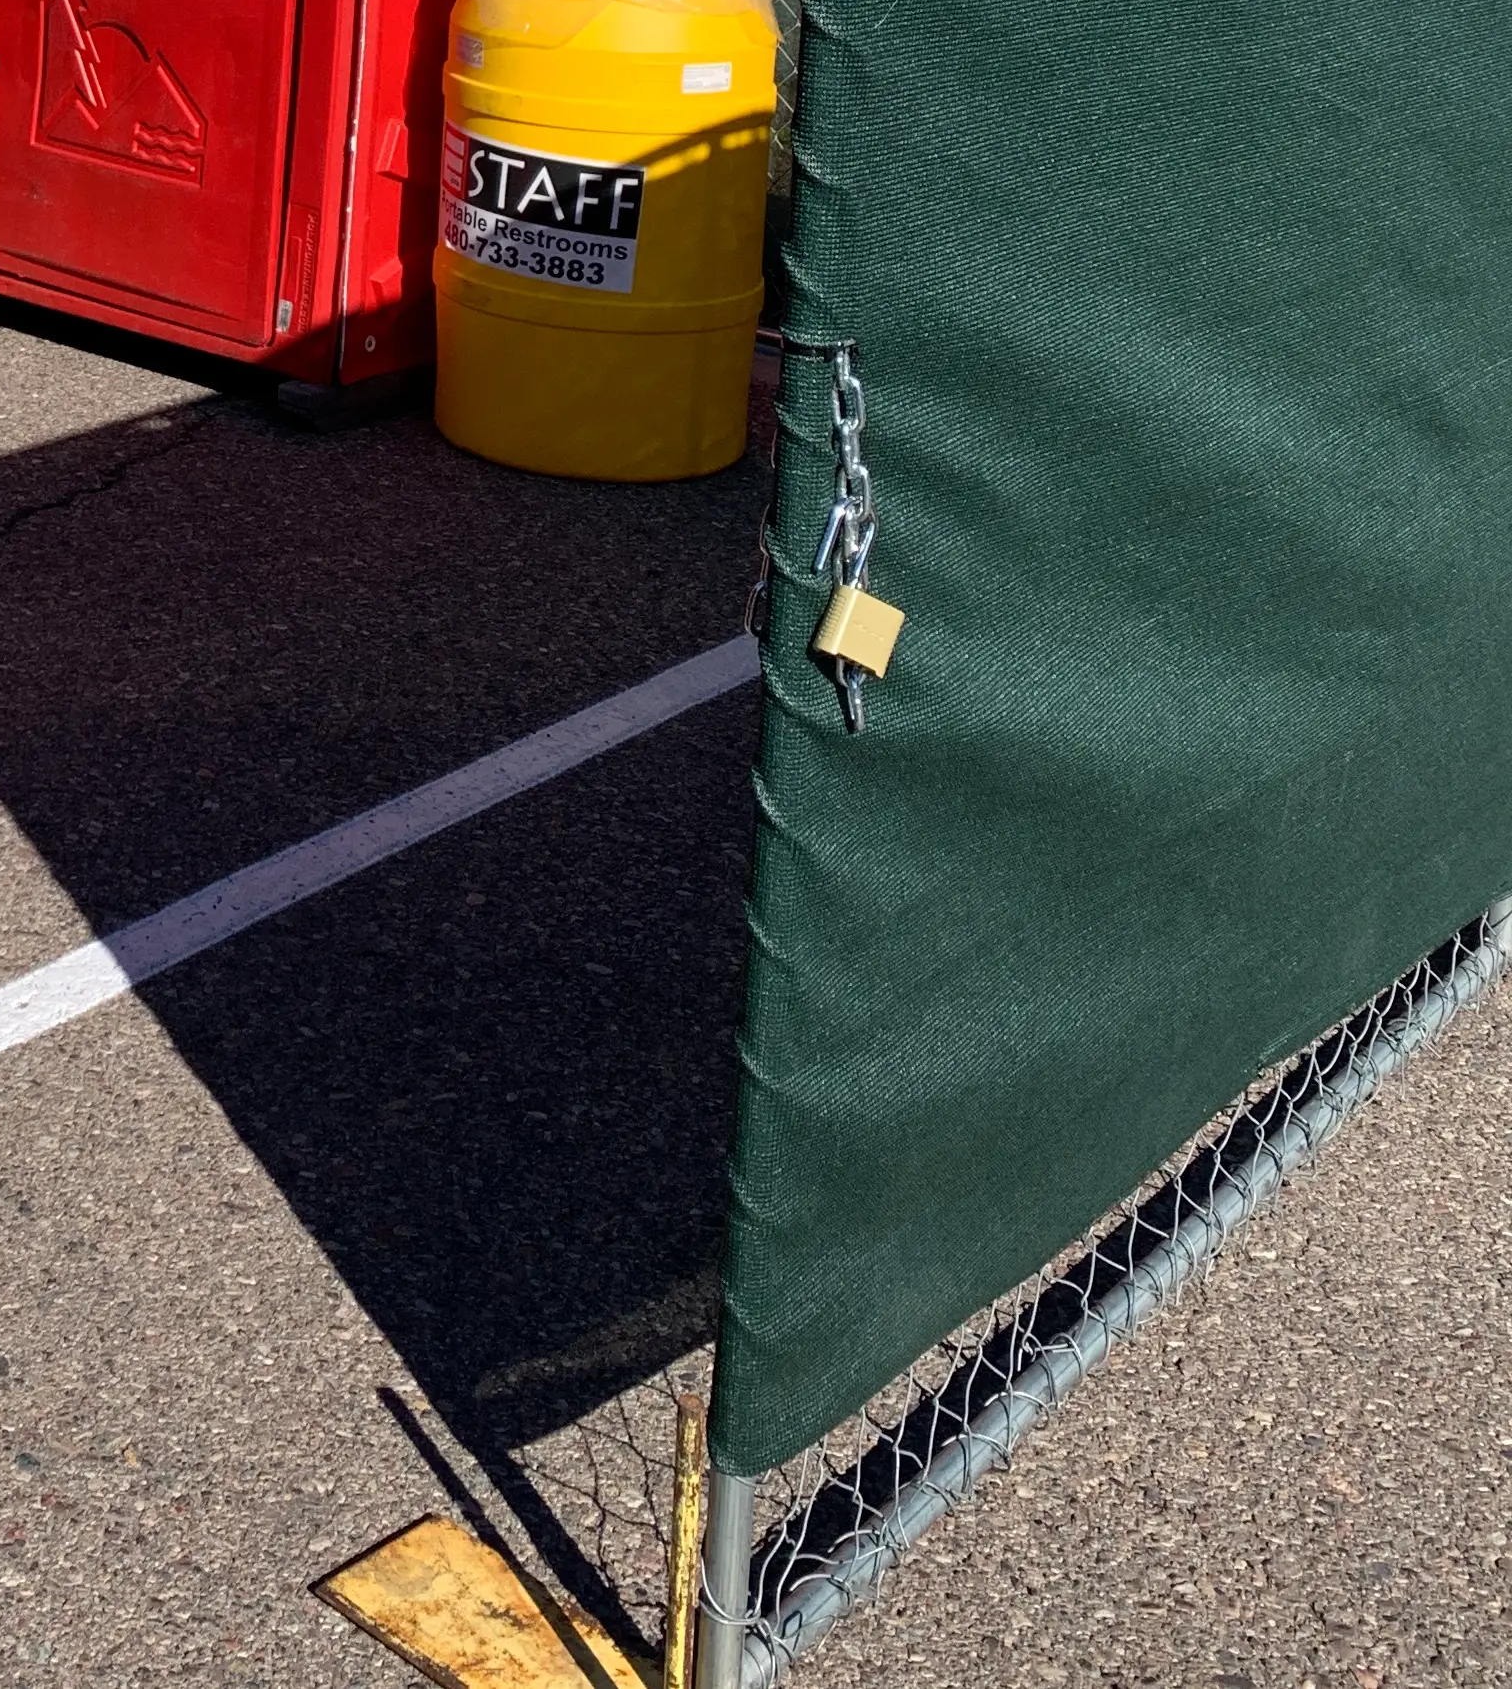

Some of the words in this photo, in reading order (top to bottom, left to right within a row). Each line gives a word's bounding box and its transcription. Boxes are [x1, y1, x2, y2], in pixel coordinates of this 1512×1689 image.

[468, 149, 639, 230] STAFF
[444, 220, 605, 285] 480-733-3883
[494, 218, 629, 261] Restrooms
